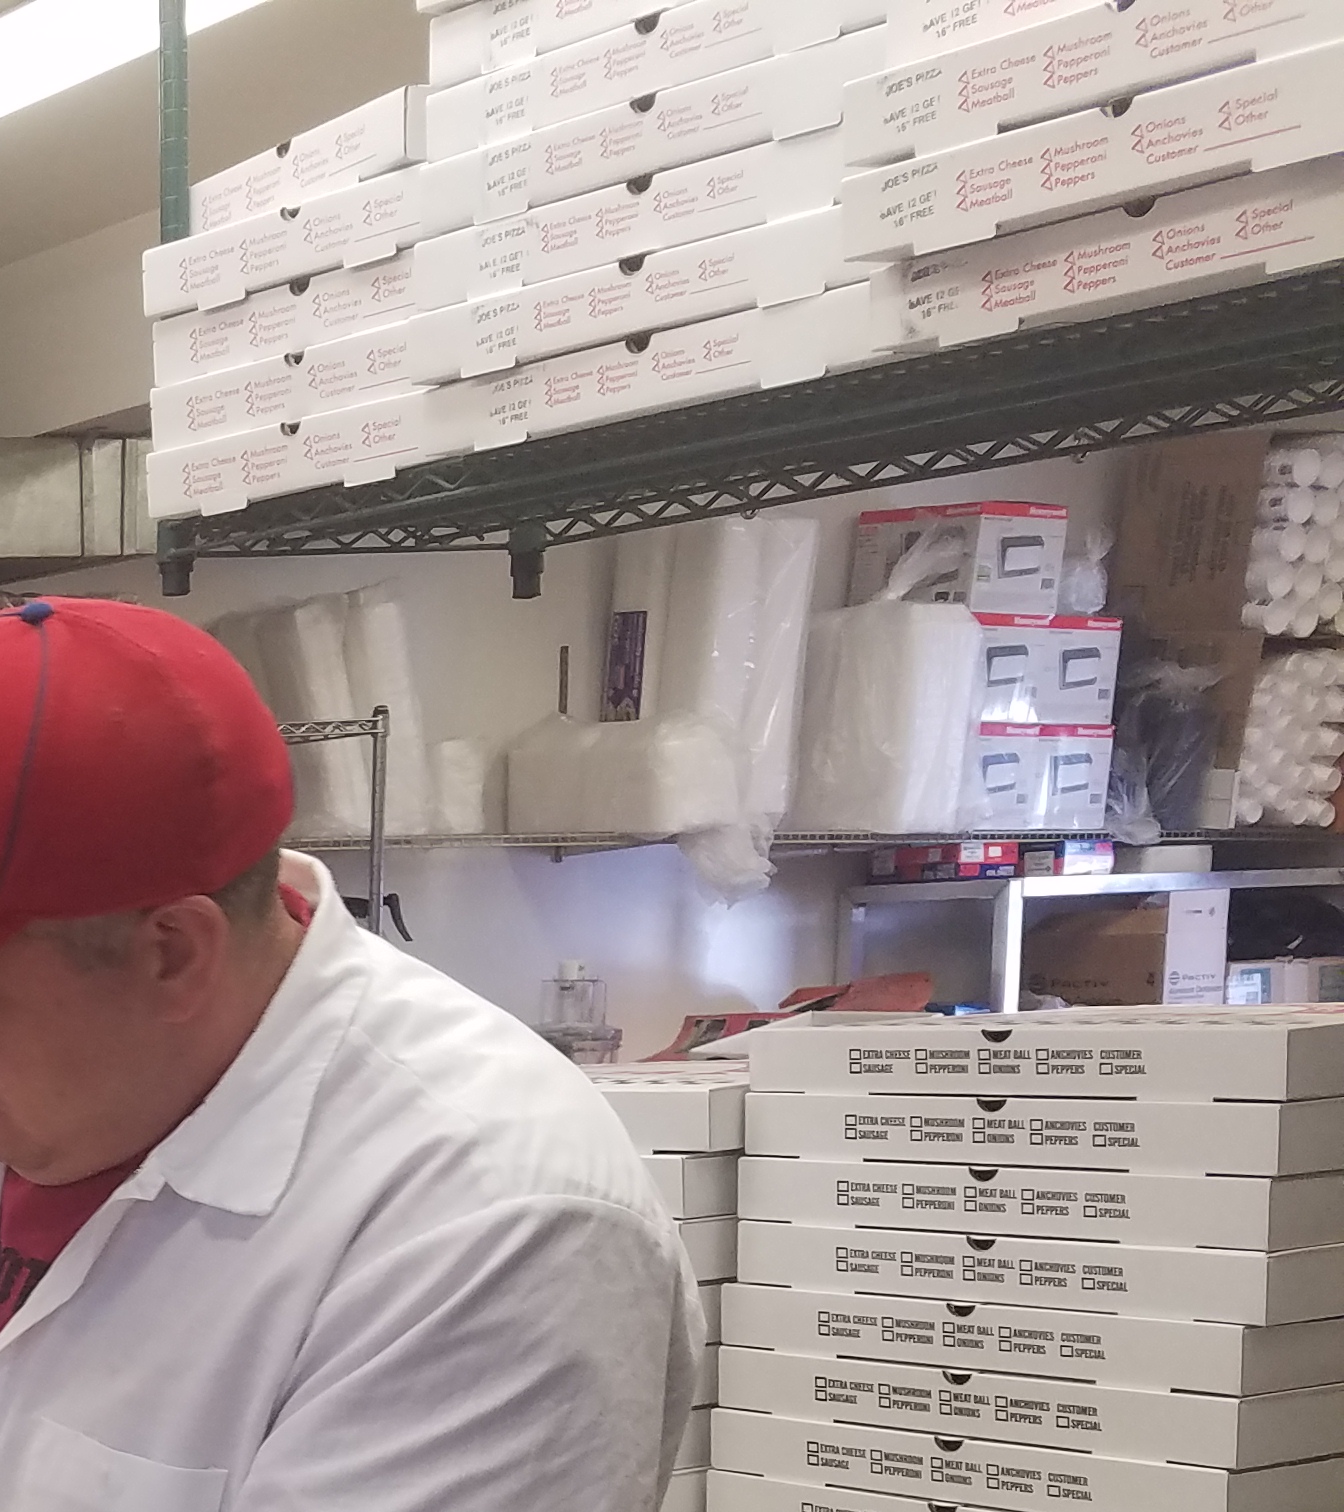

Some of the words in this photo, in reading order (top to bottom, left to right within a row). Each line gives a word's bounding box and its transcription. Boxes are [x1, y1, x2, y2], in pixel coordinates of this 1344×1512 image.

[1235, 90, 1277, 112] Special
[912, 111, 937, 126] FREE
[1146, 116, 1186, 133] Onions
[1235, 110, 1268, 126] Other
[1054, 137, 1108, 156] Mushroom
[1147, 128, 1203, 149] Anchovies
[1055, 151, 1106, 174] Pepperoni
[1147, 145, 1198, 165] Customer
[970, 165, 994, 179] Extra
[999, 156, 1033, 172] Cheese
[970, 178, 1011, 195] Sausage
[1055, 171, 1095, 189] Peppers
[970, 190, 1012, 209] Meatball
[910, 205, 935, 221] FREE
[1252, 201, 1293, 221] Special
[1167, 224, 1205, 240] Onions
[1252, 220, 1283, 236] Other
[1078, 243, 1130, 260] Mushroom
[1167, 235, 1221, 255] Anchovies
[994, 267, 1020, 281] Extra
[1023, 260, 1057, 276] Cheese
[1078, 257, 1128, 278] Pepperoni
[1166, 253, 1215, 271] Customer
[994, 279, 1035, 296] Sausage
[1078, 275, 1116, 292] Peppers
[993, 291, 1035, 309] Meatball
[863, 1051, 882, 1059] EXTRA
[993, 1051, 1011, 1059] MEAT
[1013, 1051, 1031, 1059] BALL
[1051, 1051, 1093, 1059] ANCHOVIES
[1100, 1051, 1142, 1059] CUSTOMER
[929, 1065, 968, 1073] PEPPERONI
[1051, 1065, 1085, 1074] PEPPERS
[1115, 1065, 1146, 1074] SPECIAL
[851, 1183, 870, 1192] EXTRA
[979, 1189, 997, 1198] MEAT
[999, 1190, 1017, 1199] BALL
[1036, 1191, 1078, 1202] ANCHOVIES
[1085, 1193, 1126, 1203] CUSTOMER
[916, 1200, 954, 1210] PEPPERONI
[1036, 1206, 1069, 1216] PEPPERS
[1099, 1209, 1130, 1219] SPECIAL
[831, 1314, 850, 1324] EXTRA
[957, 1325, 974, 1334] MEAT
[977, 1326, 994, 1336] BALL
[1013, 1329, 1054, 1341] ANCHOVIES
[1061, 1333, 1101, 1345] CUSTOMER
[896, 1333, 933, 1344] PEPPERONI
[1013, 1343, 1046, 1354] PEPPERS
[1075, 1349, 1106, 1360] SPECIAL
[820, 1445, 839, 1455] EXTRA
[945, 1460, 962, 1470] MEAT
[965, 1463, 982, 1473] BALL
[1001, 1467, 1042, 1480] ANCHOVIES
[1048, 1473, 1088, 1486] CUSTOMER
[884, 1466, 921, 1479] PEPPERONI
[1001, 1481, 1033, 1493] PEPPERS
[1062, 1489, 1092, 1501] SPECIAL
